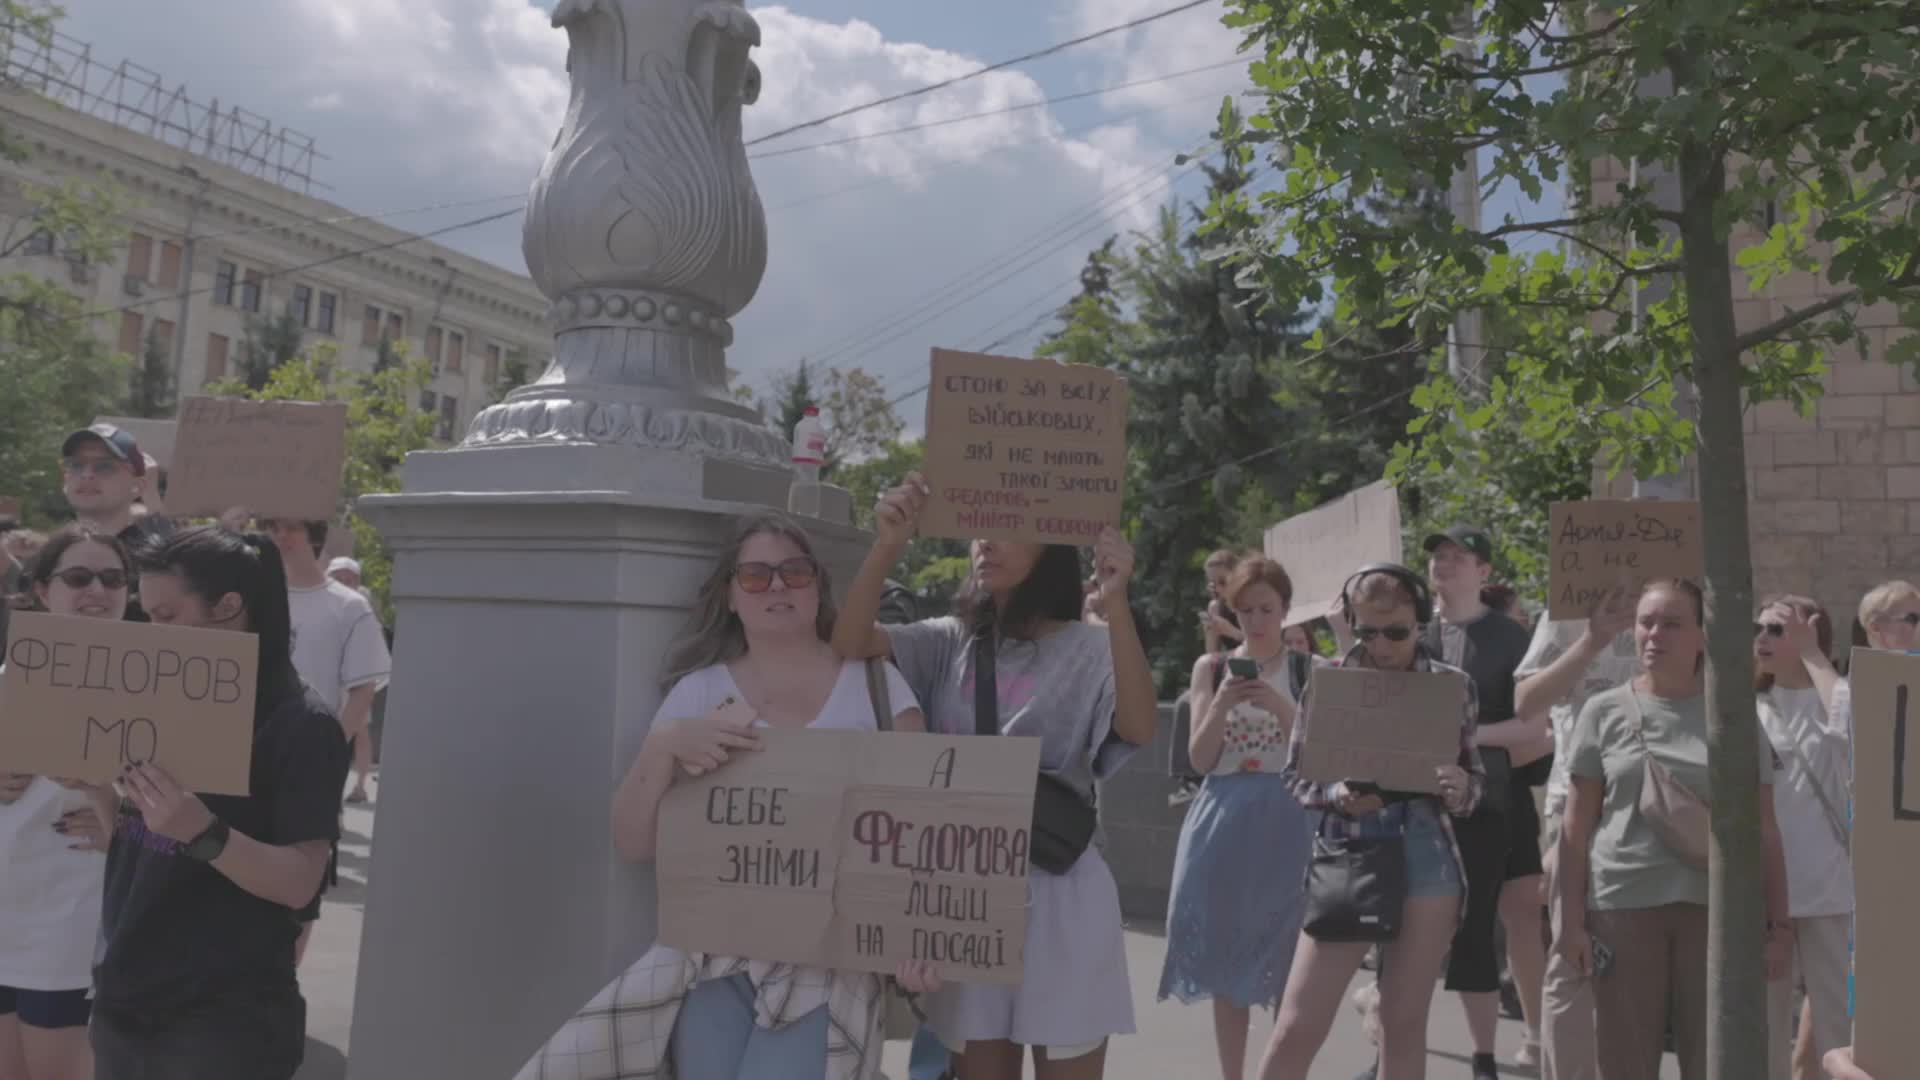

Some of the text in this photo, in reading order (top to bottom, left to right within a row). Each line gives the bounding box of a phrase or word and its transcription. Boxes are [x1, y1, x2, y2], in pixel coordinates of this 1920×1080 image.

[944, 375, 1009, 394] СТОЮ
[1017, 377, 1046, 396] ЗА
[964, 441, 1104, 466] ЯКІ НЕ МАЮТЬ
[10, 637, 241, 704] ФЕДОРОВ
[83, 715, 158, 768] МО
[706, 785, 789, 827] СЕБЕ
[717, 839, 821, 889] ЗНІМИ
[852, 809, 1029, 878] ФЕДОРОВА
[903, 880, 989, 923] ЛИШИ
[855, 923, 1007, 969] НА ПОСАДІ
